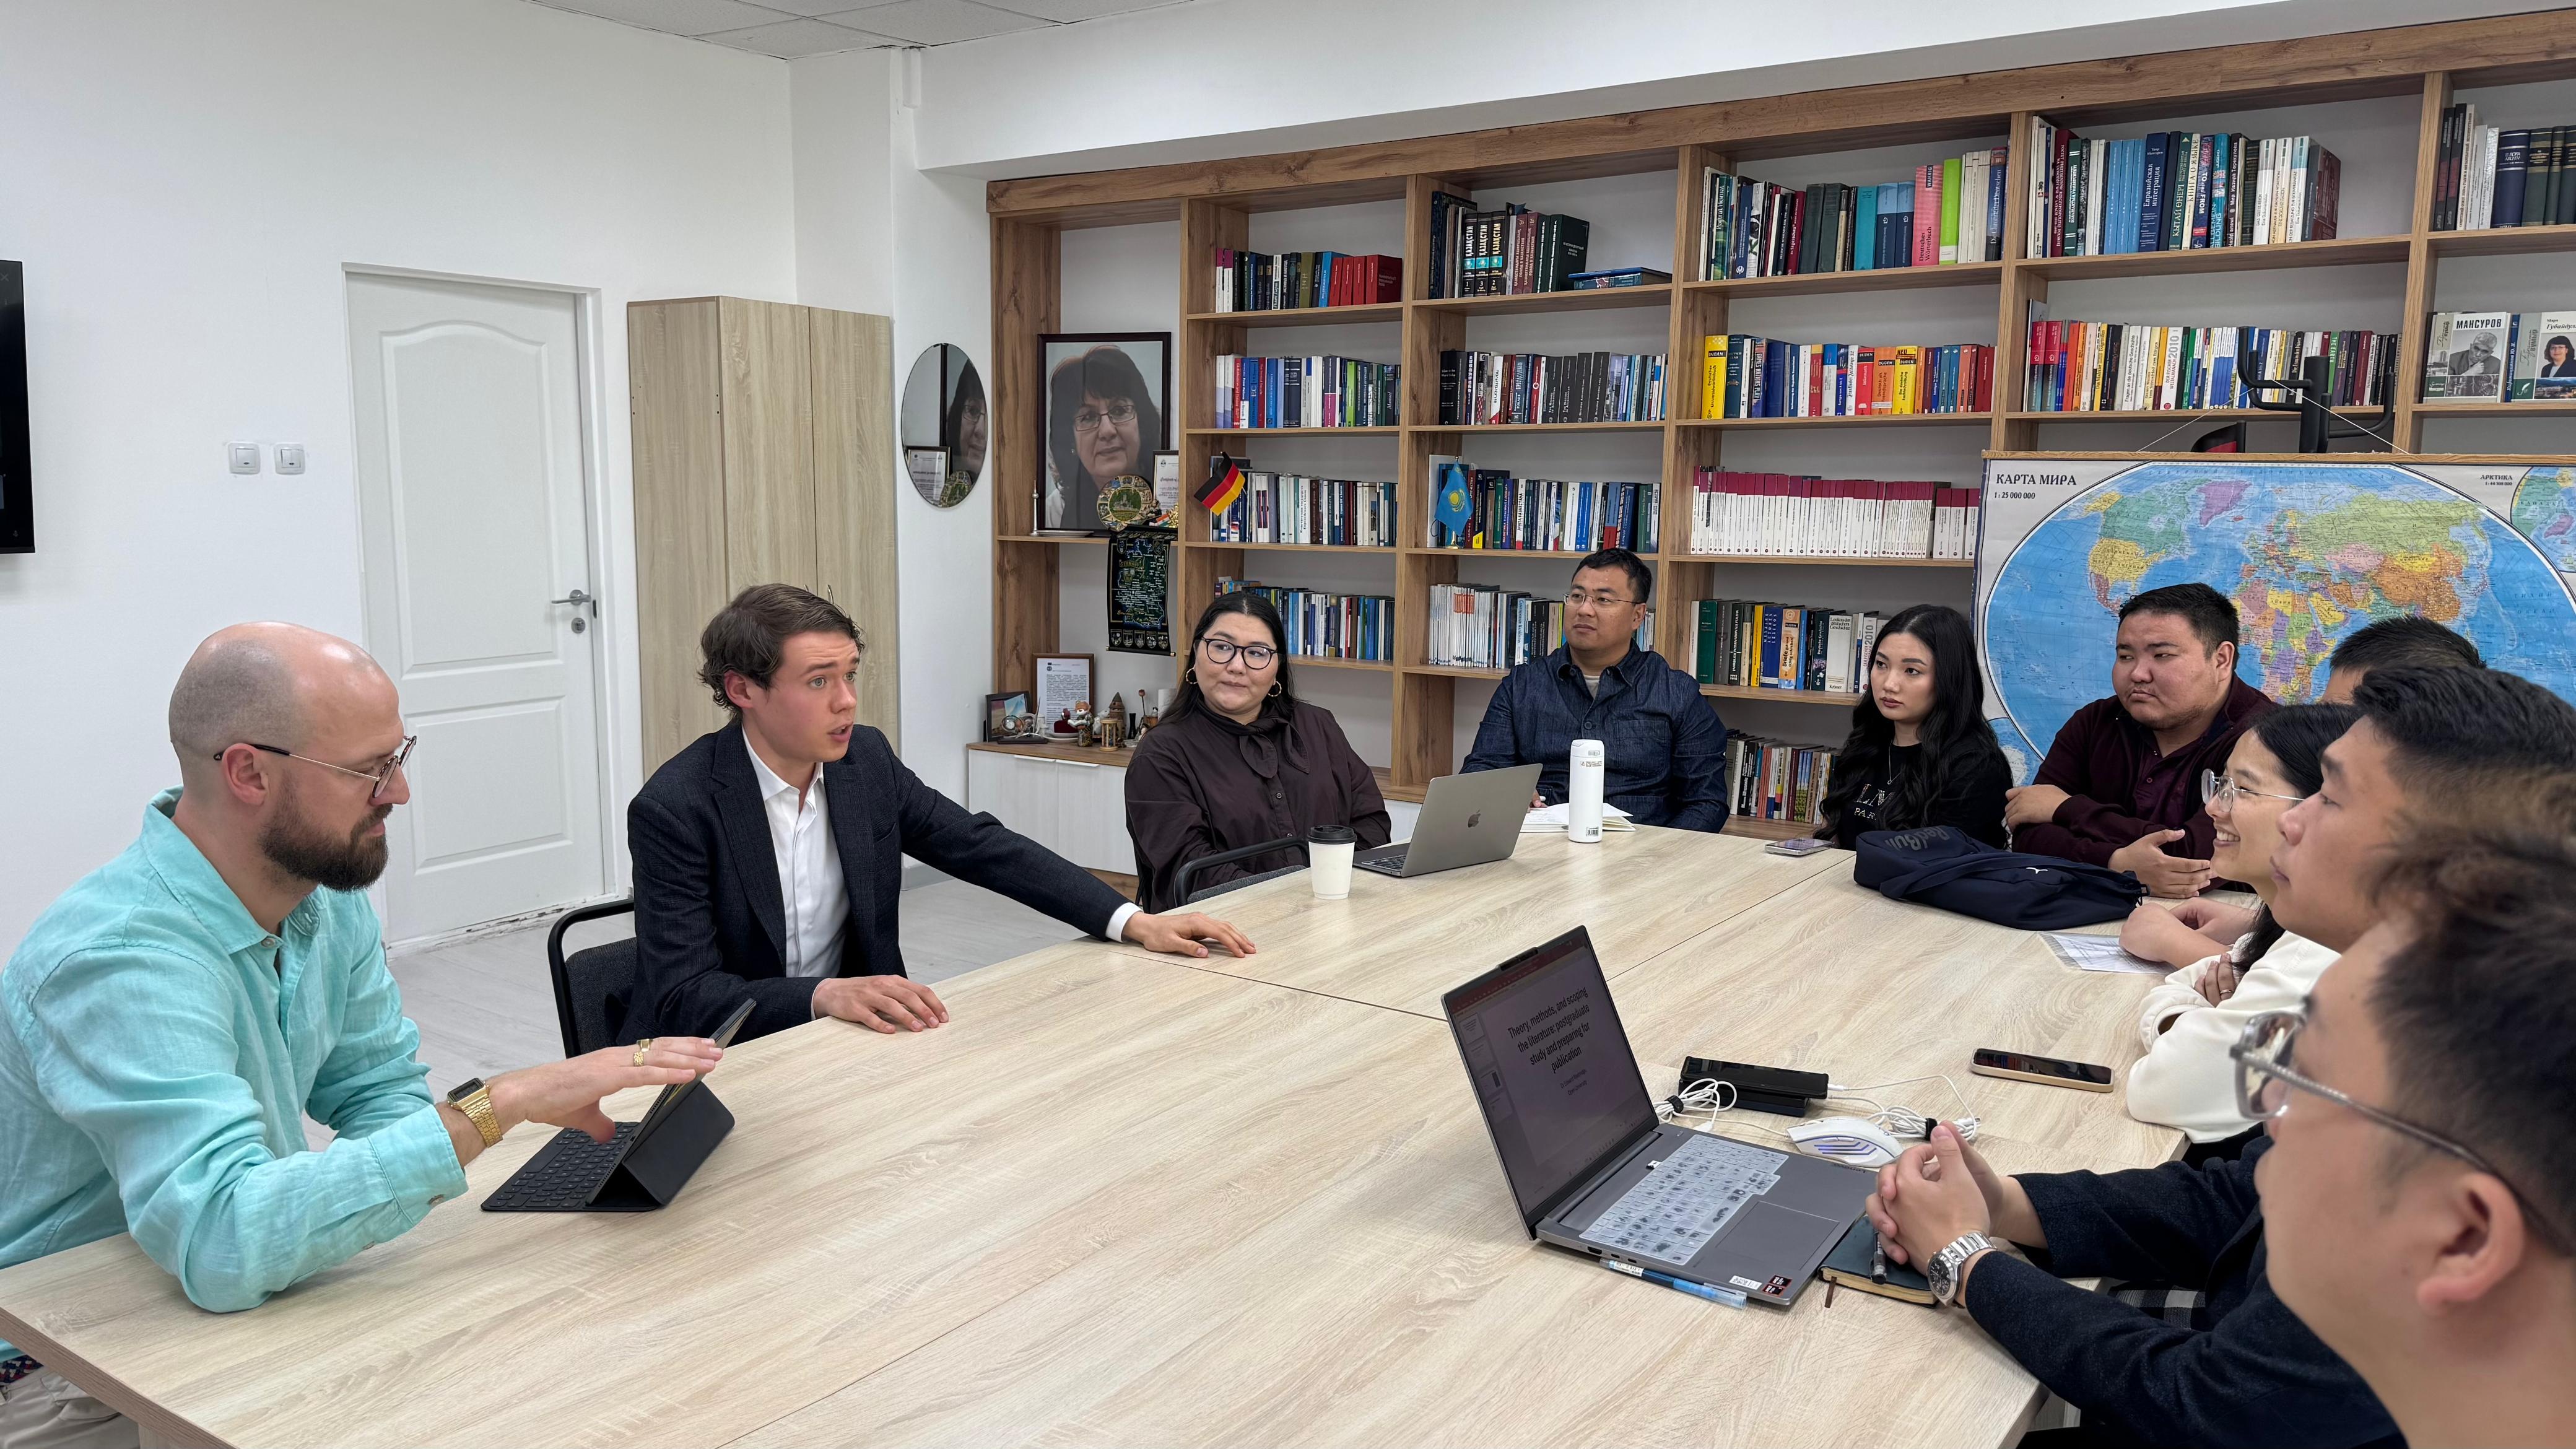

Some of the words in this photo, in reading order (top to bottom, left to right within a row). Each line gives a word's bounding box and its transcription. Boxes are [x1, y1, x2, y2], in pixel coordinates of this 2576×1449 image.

[2143, 163, 2152, 207] Евразийская
[2152, 167, 2160, 206] интеграция
[2187, 175, 2195, 202] КНИГА
[2201, 172, 2208, 181] TO
[2176, 185, 2185, 207] ӨНЕРІ
[1465, 225, 1474, 256] ҚАЗАҚСТАН
[1479, 224, 1488, 256] ҚАЗАҚСТАН
[1492, 223, 1501, 254] ҚАЗАҚСТАН
[2456, 318, 2502, 329] МАНСУРОВ
[2168, 336, 2179, 359] 2010
[1996, 473, 2037, 485] КАРТА
[2039, 474, 2077, 486] МИРА
[1865, 625, 1873, 645] 2010
[1507, 1020, 1531, 1040] Theory,
[1530, 1005, 1557, 1028] methods,
[1556, 998, 1567, 1012] and
[1567, 986, 1589, 1005] scoping
[1518, 1039, 1529, 1053] the
[1528, 1023, 1556, 1049] literature:
[1556, 1004, 1590, 1033] postgraduate
[1530, 1046, 1547, 1066] study
[1546, 1042, 1558, 1056] and
[1557, 1027, 1583, 1053] preparing
[1581, 1021, 1591, 1035] for
[1551, 1045, 1583, 1074] publication
